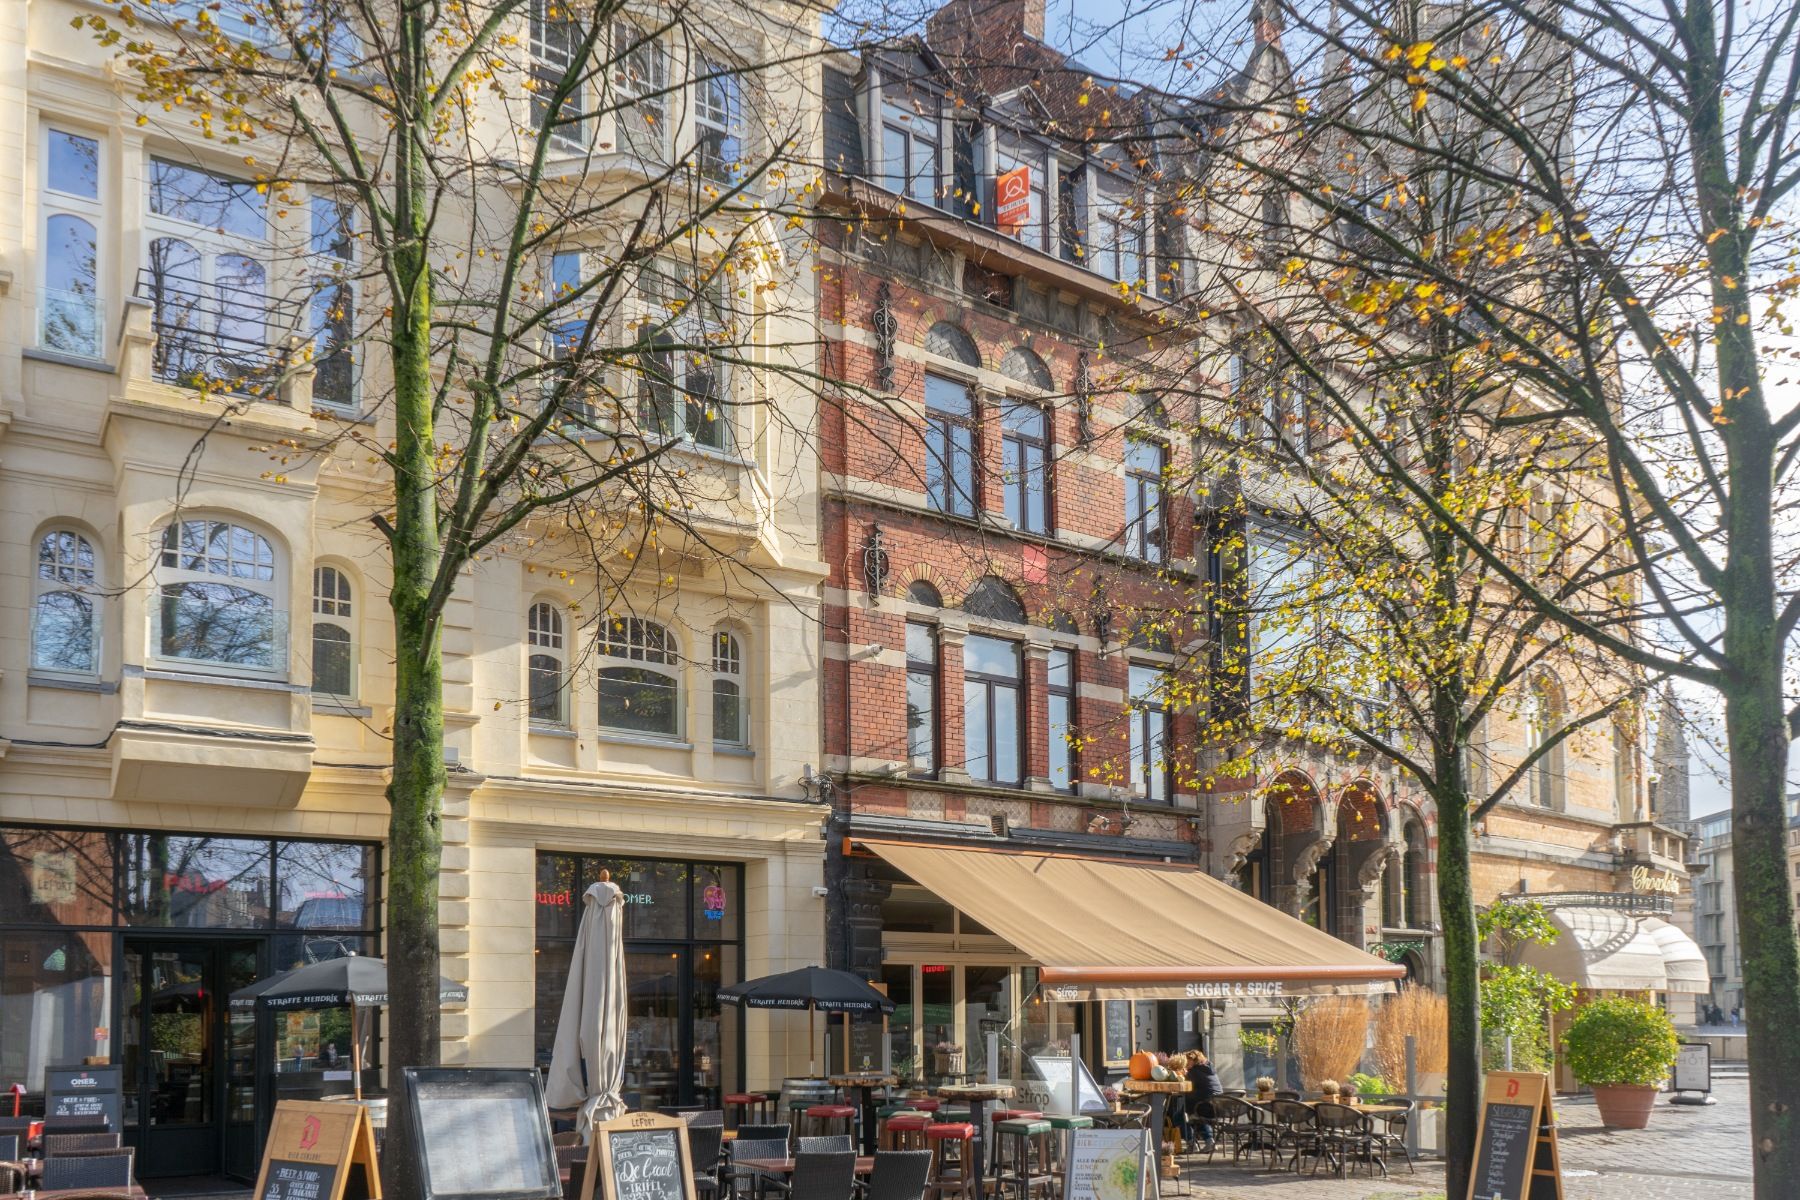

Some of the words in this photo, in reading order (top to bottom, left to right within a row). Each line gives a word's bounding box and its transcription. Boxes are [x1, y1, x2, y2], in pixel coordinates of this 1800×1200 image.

[1057, 987, 1078, 1000] Strop
[1186, 983, 1231, 997] SUGAR
[1235, 982, 1243, 996] &
[1247, 982, 1282, 996] SPICE
[267, 996, 301, 1006] STRAFFE
[304, 994, 338, 1003] HENDRIK
[356, 993, 389, 1002] STRAFFE
[750, 998, 775, 1006] STRAFFE
[777, 999, 805, 1007] HENDRIK
[1018, 1087, 1050, 1109] Strop
